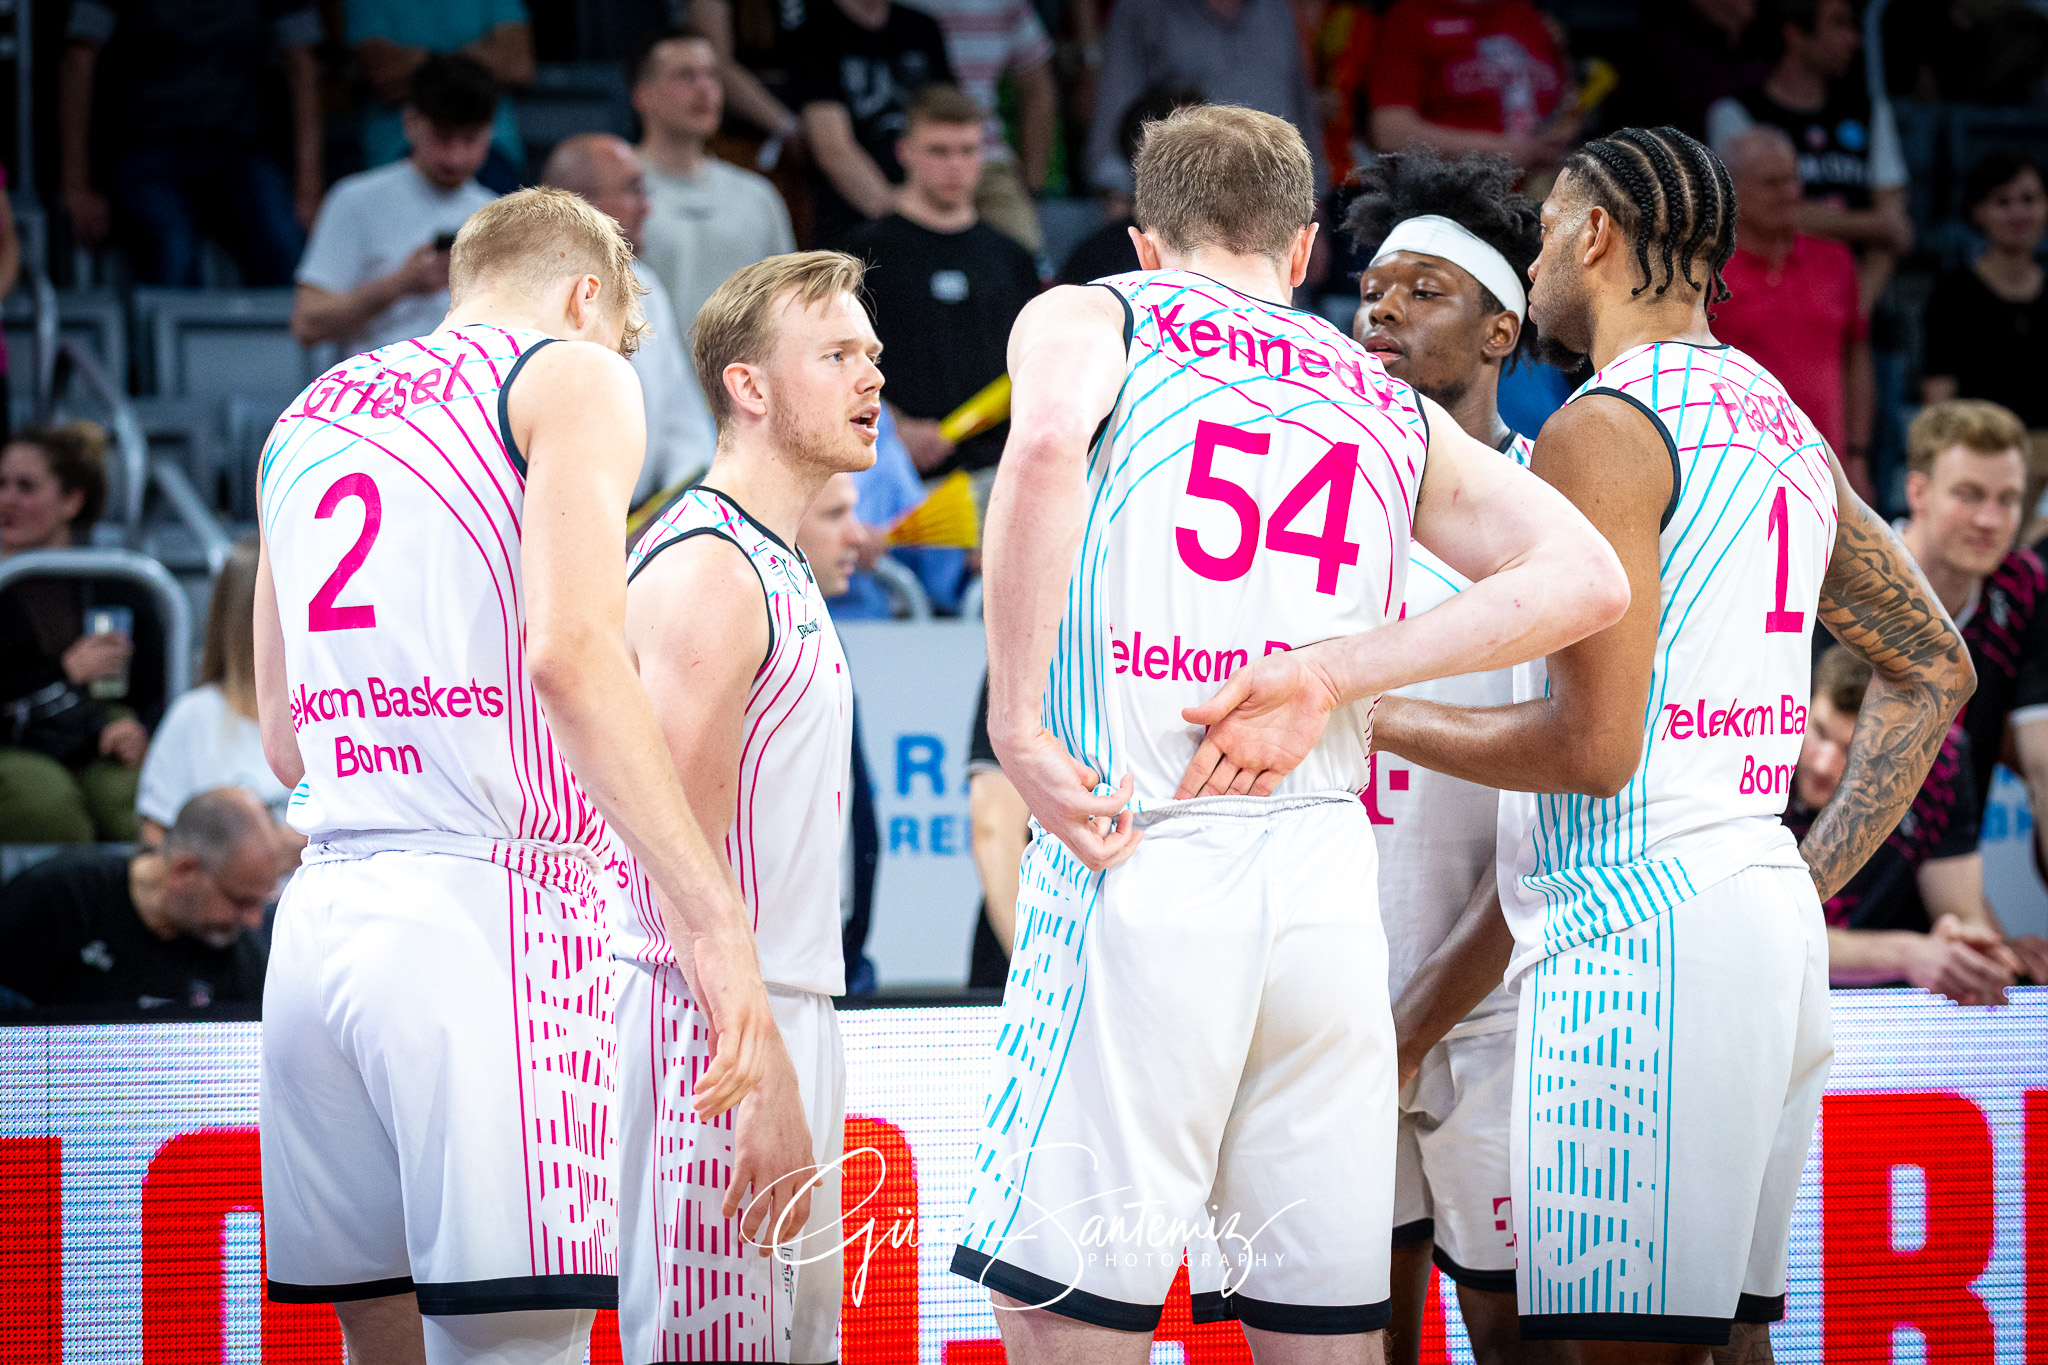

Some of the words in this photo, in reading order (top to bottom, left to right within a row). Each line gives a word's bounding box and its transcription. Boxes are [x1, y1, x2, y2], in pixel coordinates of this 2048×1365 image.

[303, 353, 467, 419] Griesel
[1151, 303, 1394, 411] Kennedy
[1709, 382, 1806, 447] Flagg
[1175, 419, 1360, 596] 54
[308, 472, 382, 632] 2
[1765, 486, 1805, 634] 1
[1110, 631, 1248, 682] elekom
[367, 675, 504, 718] Baskets
[1661, 698, 1774, 742] Telekom
[334, 735, 423, 779] Bonn
